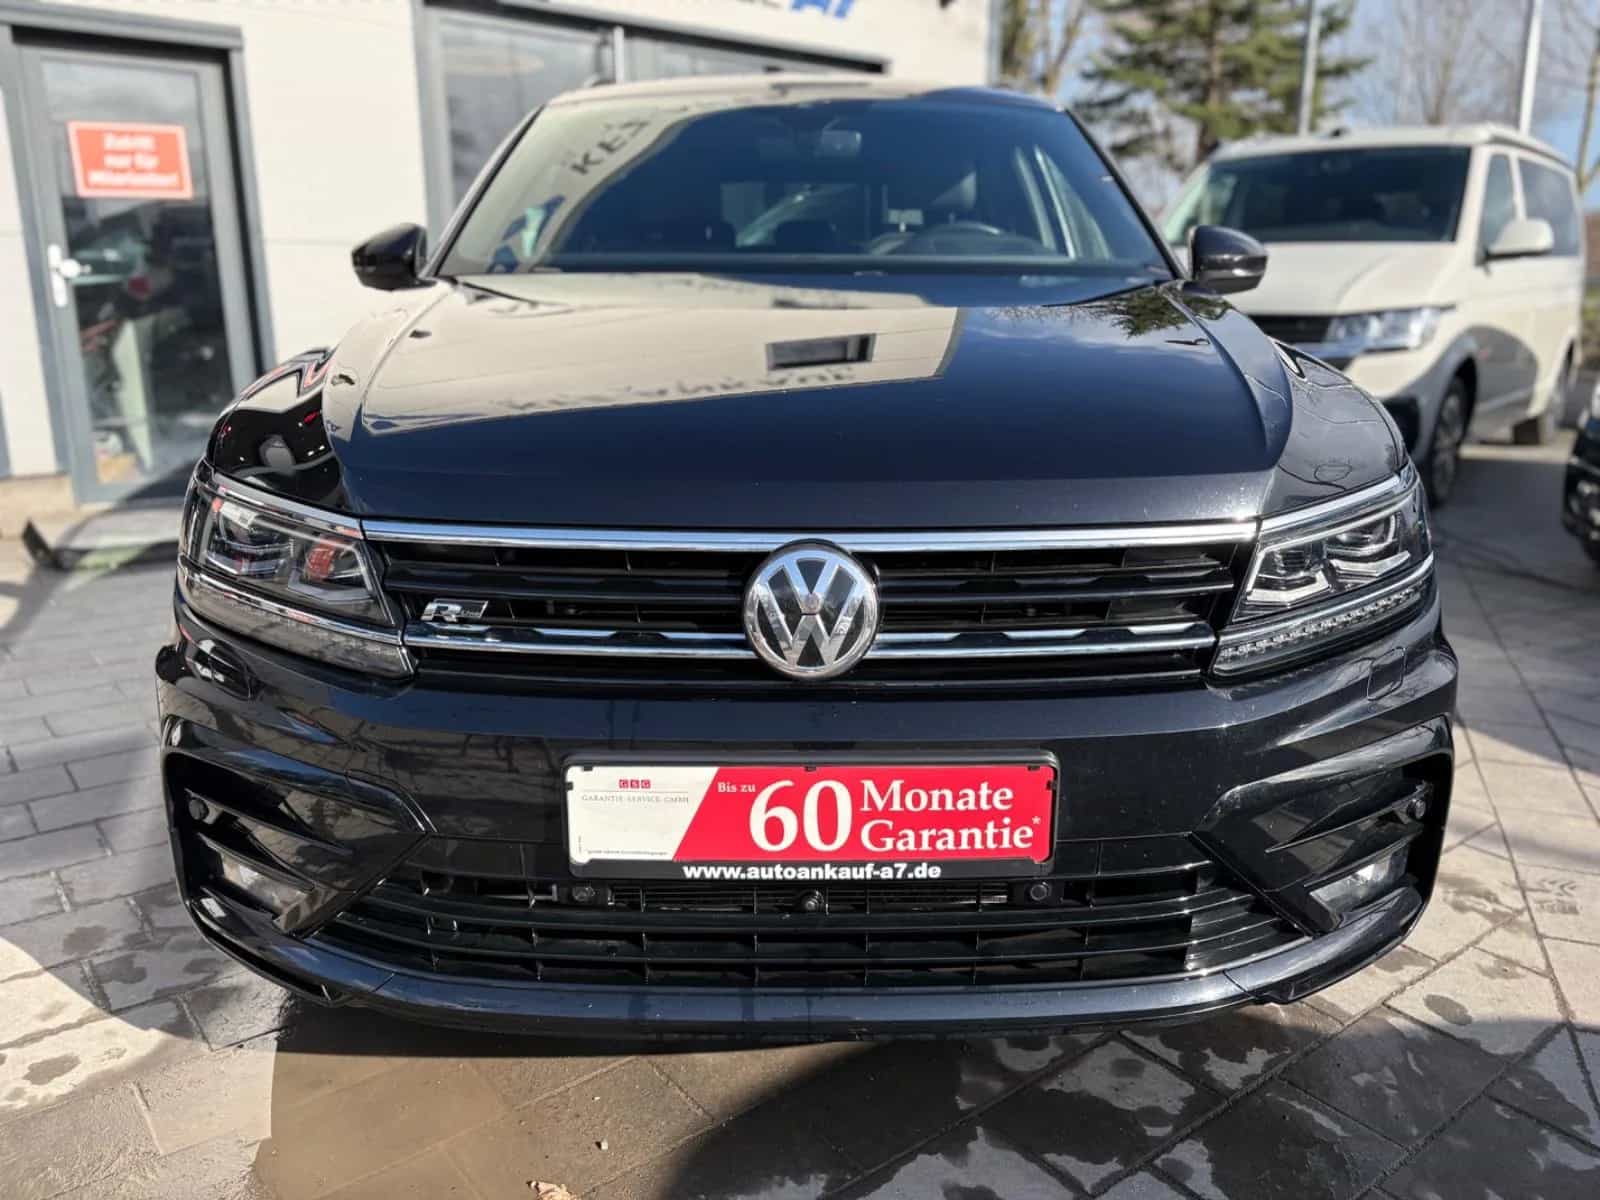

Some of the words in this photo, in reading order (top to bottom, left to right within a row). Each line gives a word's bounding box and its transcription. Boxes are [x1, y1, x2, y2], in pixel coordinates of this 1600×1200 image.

[717, 782, 737, 793] Bis
[740, 784, 756, 793] zu
[860, 779, 1014, 812] Monate
[750, 779, 853, 852] 60
[683, 862, 941, 880] www.autoankauf-a7.de
